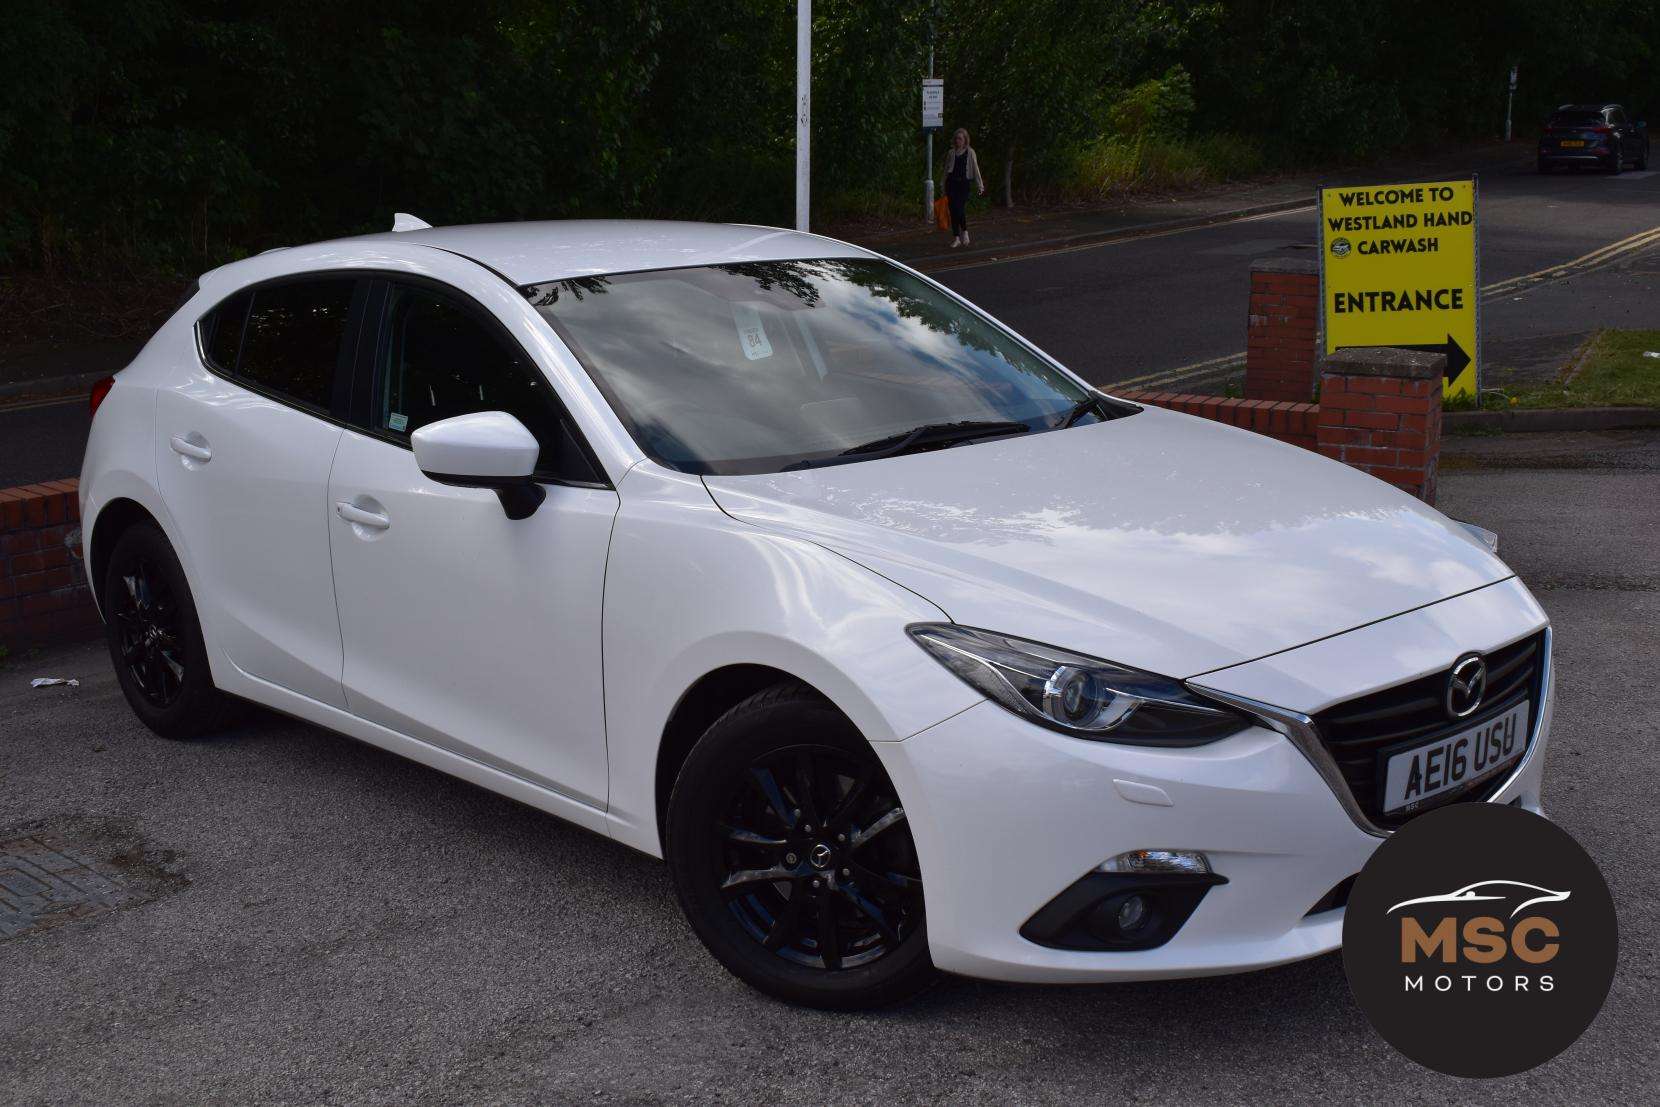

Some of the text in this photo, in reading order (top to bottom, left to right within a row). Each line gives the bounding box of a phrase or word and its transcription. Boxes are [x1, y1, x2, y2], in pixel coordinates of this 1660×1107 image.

[1339, 187, 1454, 207] WELCOME TO
[1328, 211, 1473, 232] WESTLAND HAND
[1357, 238, 1439, 255] CARWASH
[1334, 288, 1464, 314] ENTRANCE
[1404, 713, 1517, 800] AE16 USU
